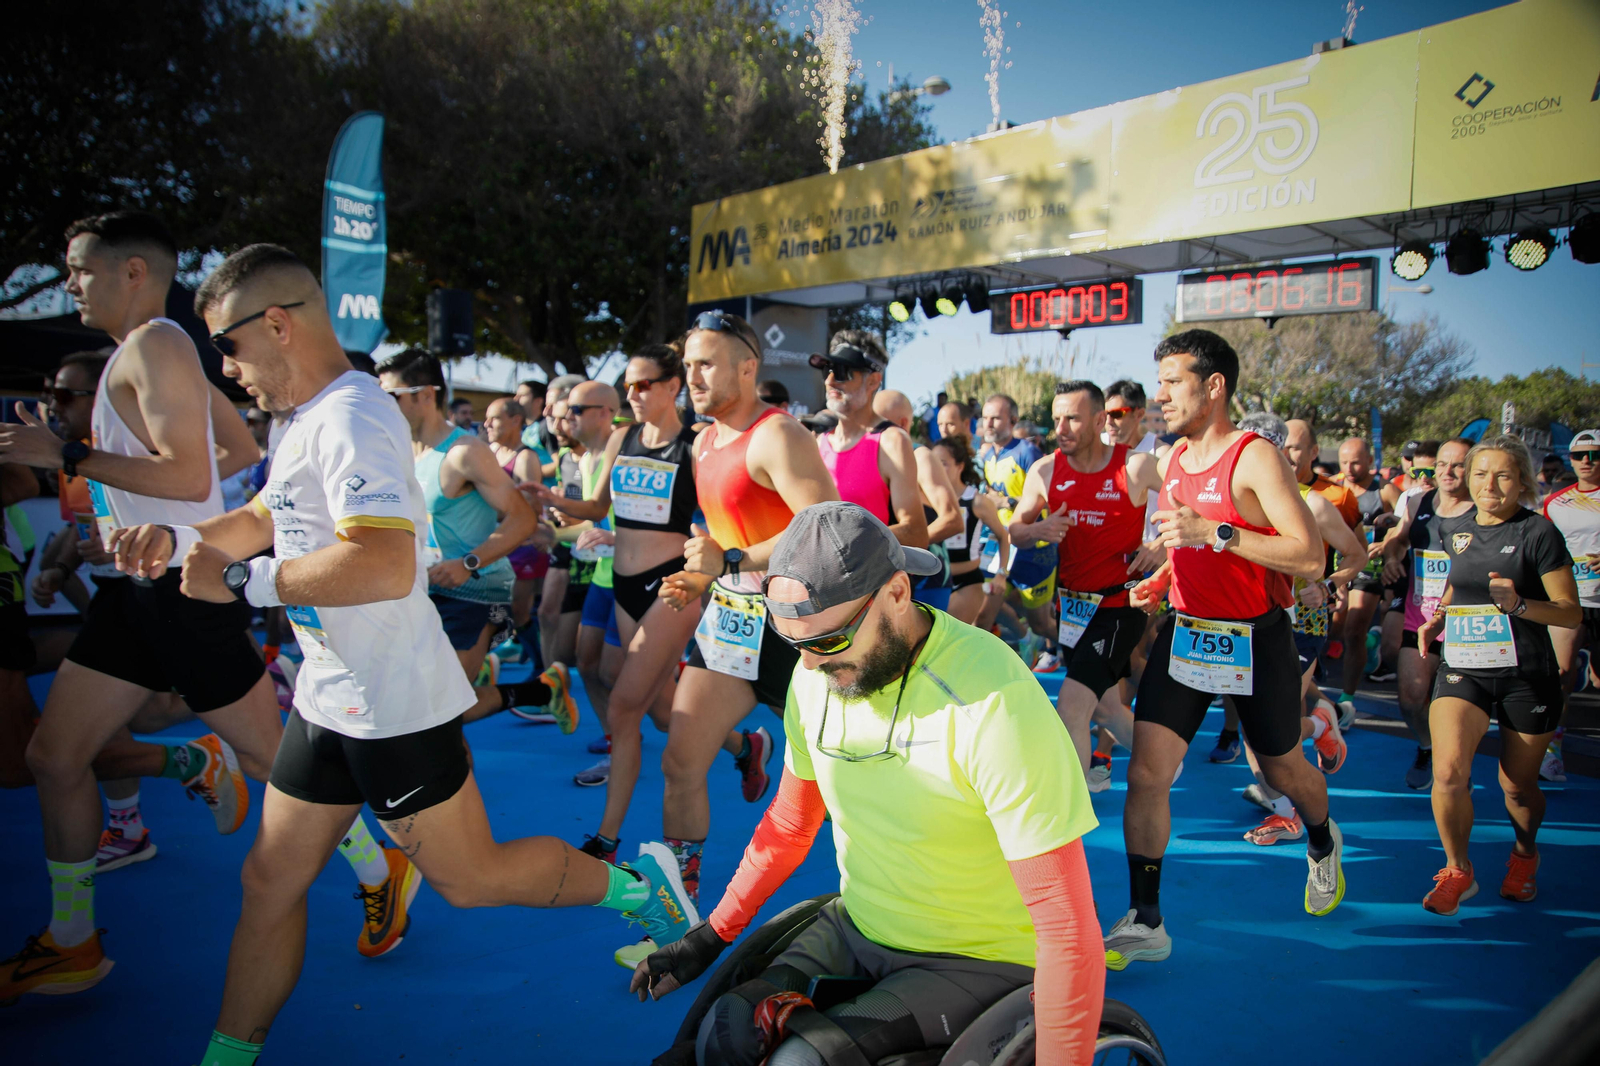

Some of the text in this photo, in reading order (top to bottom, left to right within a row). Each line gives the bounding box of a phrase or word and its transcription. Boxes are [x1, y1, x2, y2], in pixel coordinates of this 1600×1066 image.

[1452, 96, 1562, 127] COOPERACIÓN
[1194, 73, 1319, 188] 25
[1451, 124, 1486, 140] 2005
[334, 196, 376, 220] TIEMPO
[1192, 176, 1317, 217] EDICIÓN
[778, 200, 899, 235] Medio Maratón
[908, 219, 955, 239] RAMÓN
[959, 215, 992, 232] RUIZ
[777, 221, 898, 260] Almería 2024
[617, 466, 668, 490] 1378
[1427, 560, 1448, 573] 80
[1066, 599, 1095, 619] 2034
[1453, 615, 1505, 636] 1154
[1188, 630, 1234, 655] 759
[1187, 650, 1203, 660] JUAN
[1203, 654, 1235, 663] ANTONIO
[657, 885, 685, 924] HOKA
